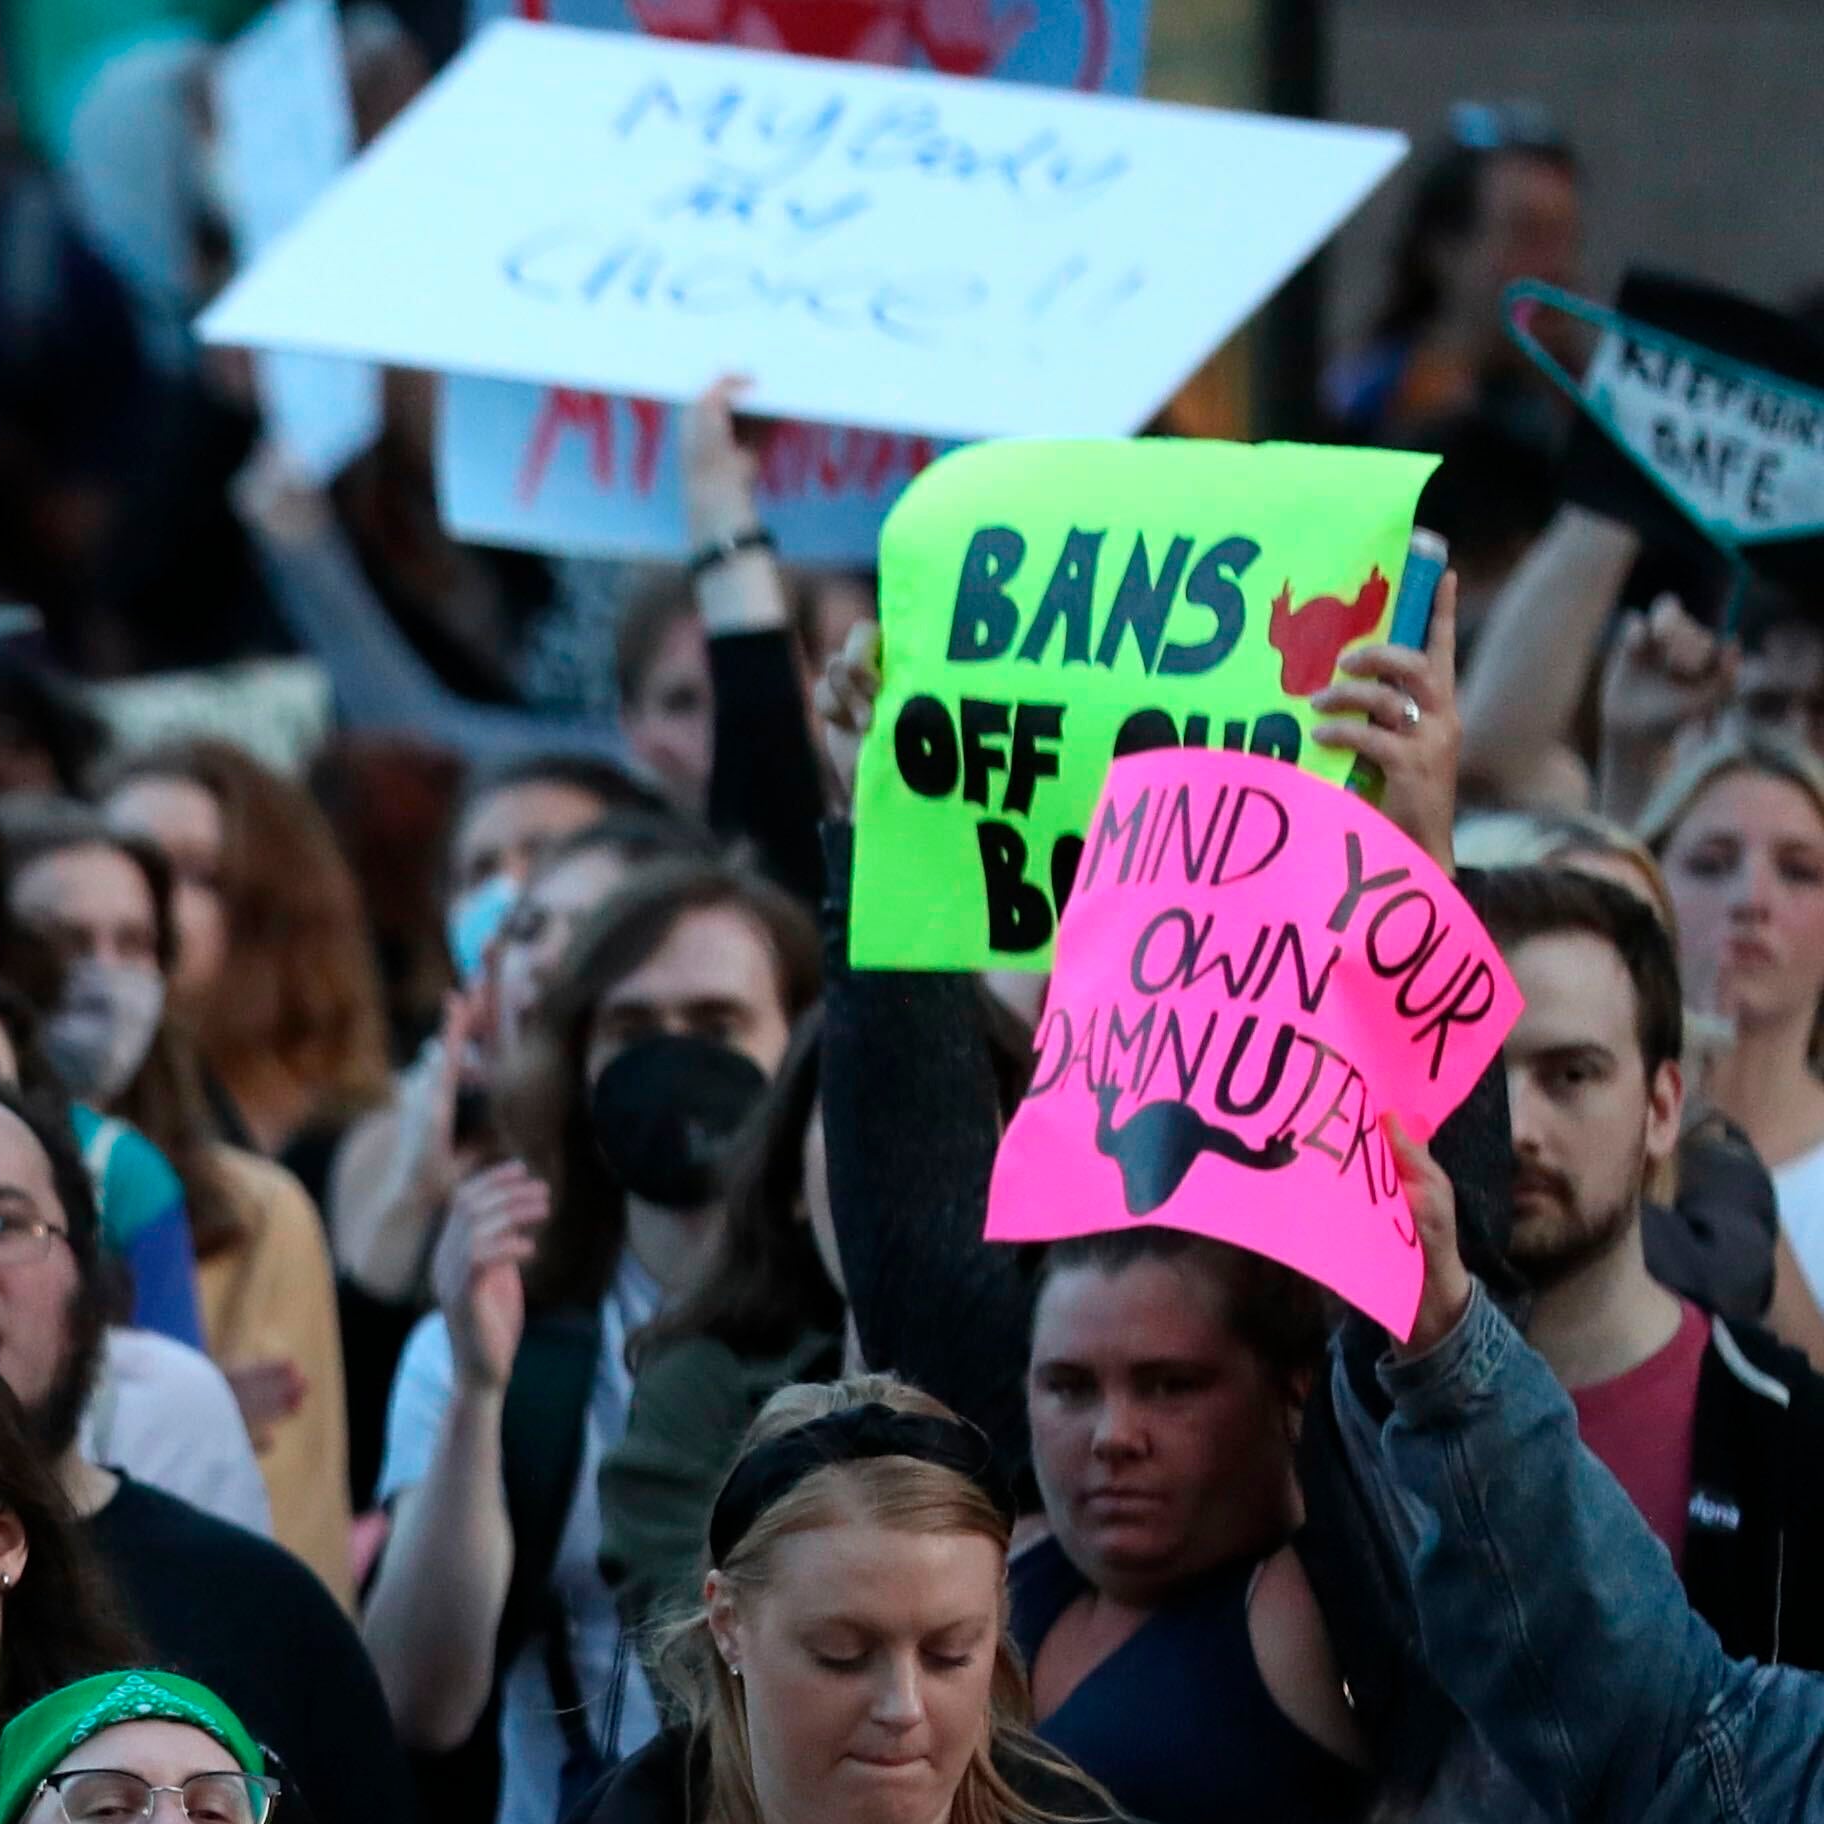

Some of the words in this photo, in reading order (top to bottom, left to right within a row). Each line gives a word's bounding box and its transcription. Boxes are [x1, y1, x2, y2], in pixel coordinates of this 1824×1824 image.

[947, 525, 1262, 677] BANS
[893, 695, 1066, 814] OFF
[1079, 783, 1290, 892] MIND
[1327, 833, 1497, 1080] YOUR
[1131, 907, 1341, 1013] OWN
[1027, 1000, 1219, 1104] DAMN
